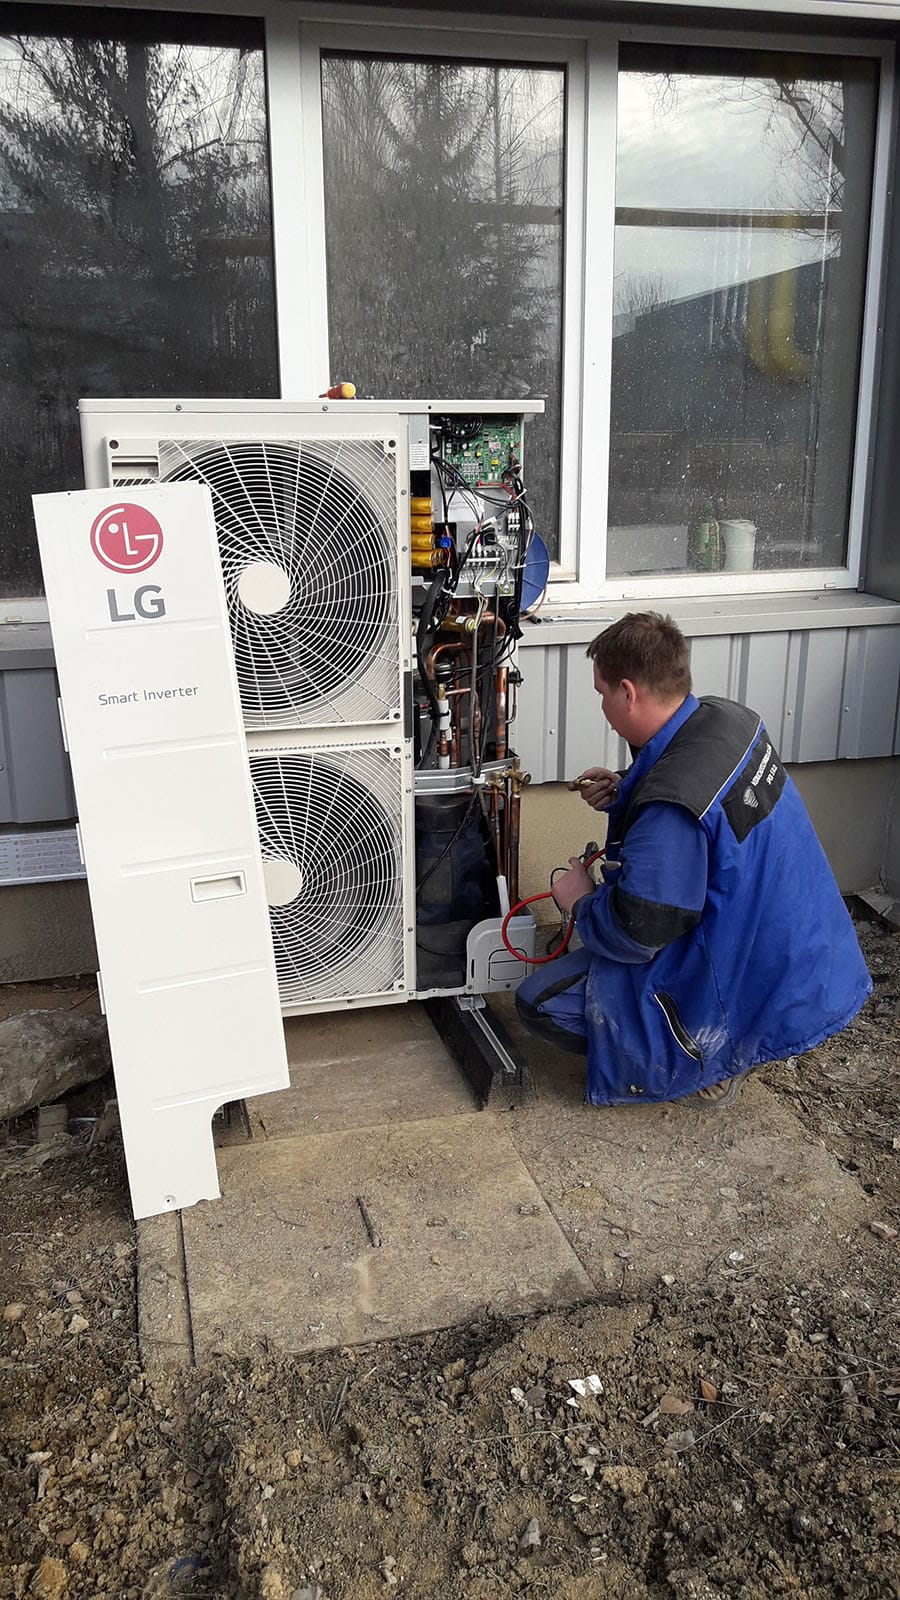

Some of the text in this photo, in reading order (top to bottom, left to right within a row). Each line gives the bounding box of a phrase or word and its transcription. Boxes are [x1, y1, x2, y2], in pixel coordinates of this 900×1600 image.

[107, 584, 166, 622] LG
[98, 686, 199, 706] Smart Inverter
